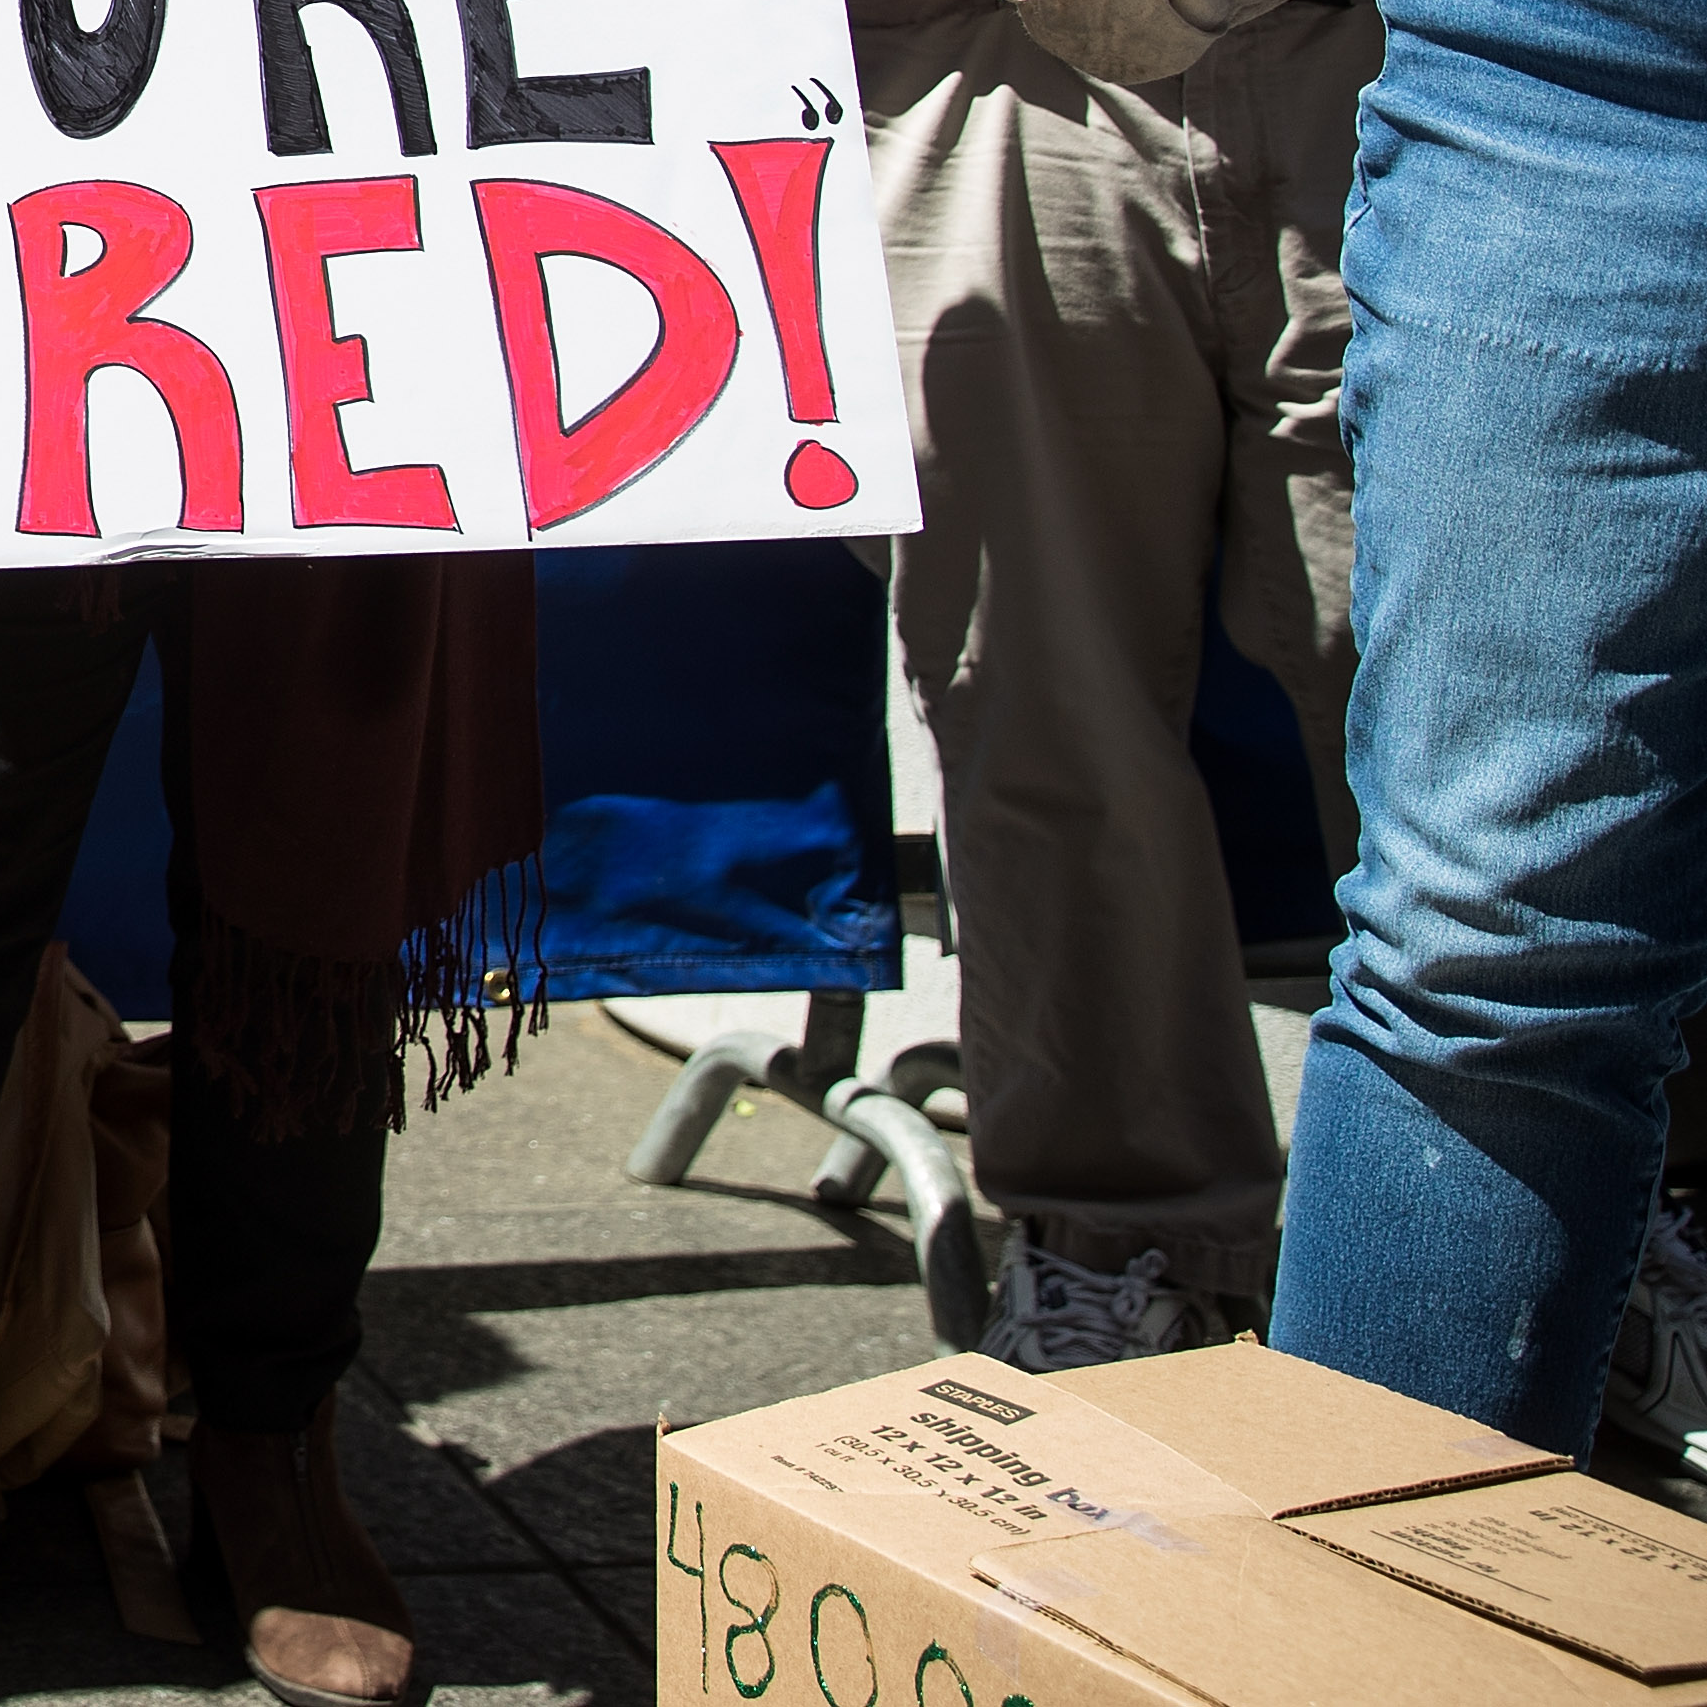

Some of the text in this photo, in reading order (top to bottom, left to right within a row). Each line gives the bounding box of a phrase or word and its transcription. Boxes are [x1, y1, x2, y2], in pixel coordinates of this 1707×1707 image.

[934, 1382, 1022, 1420] STAPLES
[870, 1424, 1048, 1520] 12 x 12 x 12 in
[892, 1464, 938, 1488] 30.5
[910, 1411, 1109, 1523] shipping box
